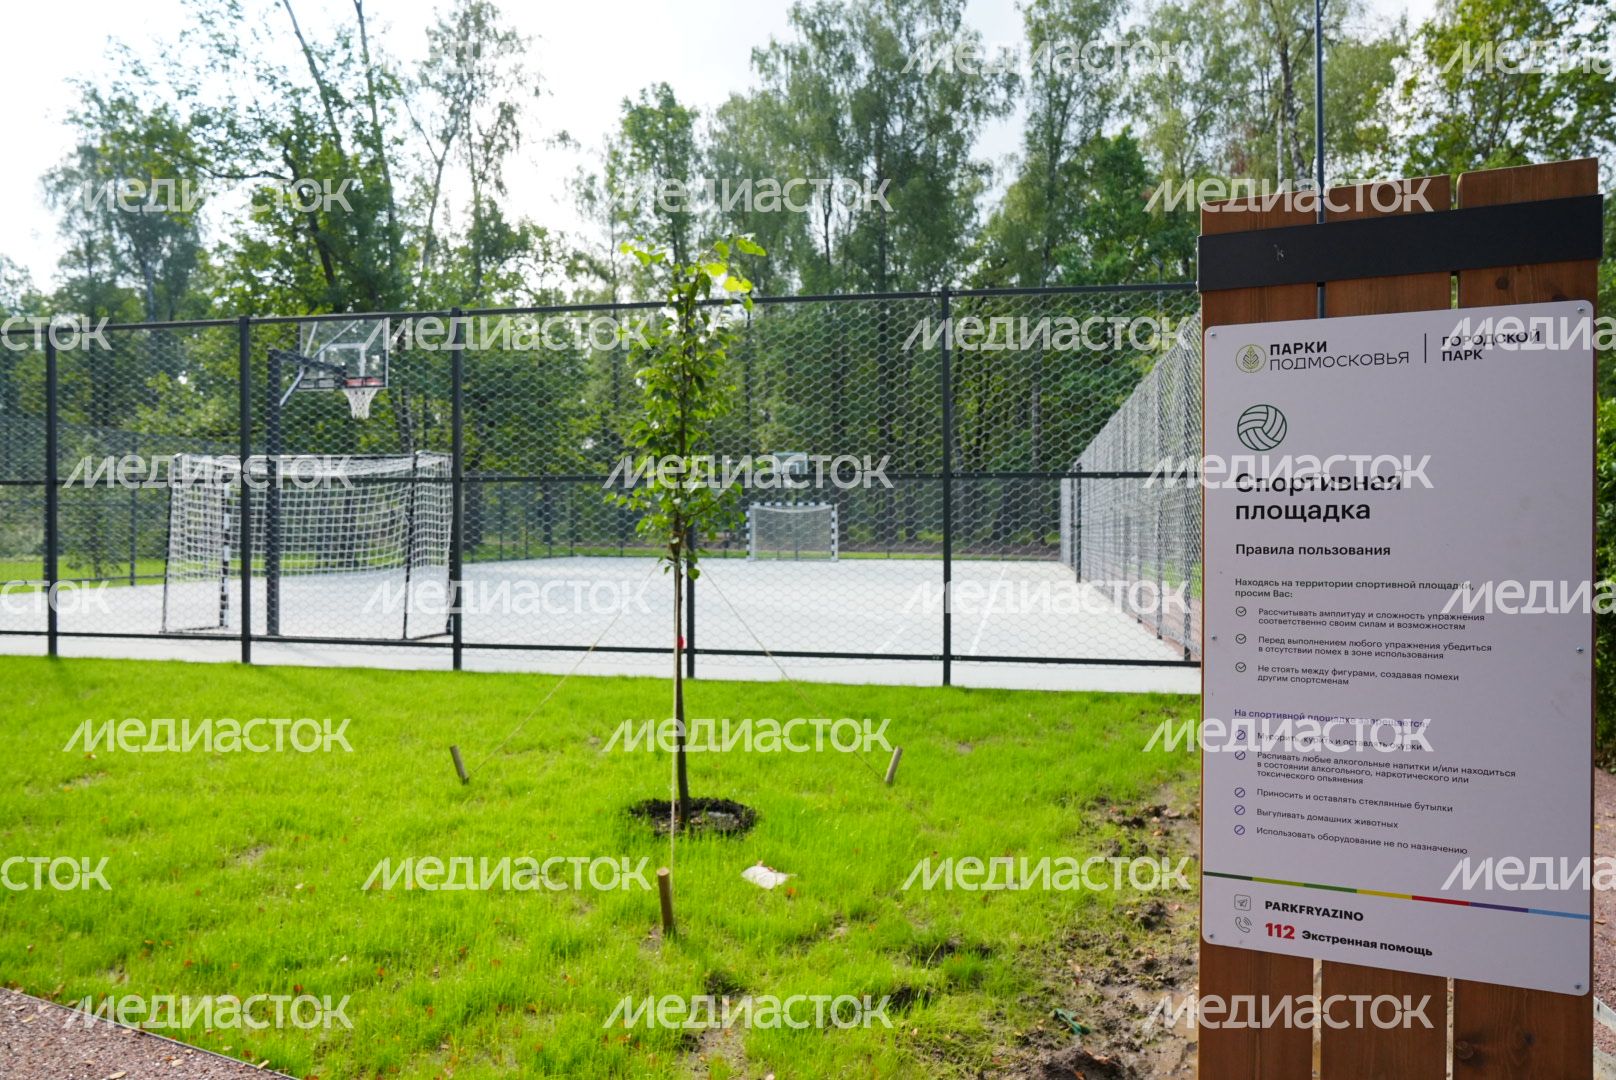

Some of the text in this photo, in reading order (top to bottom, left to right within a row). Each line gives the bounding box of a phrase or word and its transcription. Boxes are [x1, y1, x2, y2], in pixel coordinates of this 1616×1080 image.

[1442, 328, 1540, 346] ГОРОДСКОЙ
[1270, 341, 1328, 356] ПАРКИ
[1442, 349, 1482, 362] ПАРК
[1270, 351, 1408, 371] ПОДМОСКОВЬЯ
[1235, 473, 1400, 496] Спортивная
[1236, 504, 1370, 523] площадка
[1236, 543, 1390, 556] Правила пользования
[1235, 578, 1279, 587] Находясь
[1295, 580, 1353, 589] территории
[1355, 580, 1415, 589] спортивной
[1235, 589, 1292, 598] просим Вас:
[1258, 608, 1317, 617] Рассчитывать
[1319, 611, 1366, 621] амплитуду
[1376, 612, 1425, 621] сложность
[1427, 613, 1484, 622] упражнения
[1258, 618, 1326, 626] соответственно
[1359, 621, 1386, 629] силам
[1397, 622, 1466, 631] возможностям
[1258, 636, 1491, 652] Перед выполнением любого упражнения убедиться
[1265, 646, 1312, 655] отсутствии
[1314, 648, 1341, 656] помех
[1351, 649, 1372, 657] зоне
[1374, 651, 1443, 659] использования
[1257, 674, 1348, 685] другим спортсменам
[1258, 665, 1458, 681] Не стоять между фигурами, создавая помехи
[1234, 709, 1247, 717] На
[1248, 711, 1305, 721] спортивной
[1257, 751, 1515, 777] Распивать любые алкогольные напитки и/или находиться
[1257, 770, 1363, 785] токсического опьянения
[1263, 762, 1309, 771] состоянии
[1311, 765, 1372, 777] алкогольного,
[1375, 771, 1449, 782] наркотического
[1452, 776, 1469, 784] или
[1256, 788, 1303, 800] Приносить
[1312, 794, 1356, 804] оставлять
[1358, 798, 1412, 809] стеклянные
[1414, 801, 1452, 812] бутылки
[1256, 808, 1398, 829] Выгуливать домашних животных
[1256, 827, 1467, 855] Использовать оборудование не по назначению
[1265, 901, 1363, 921] PARKFRYAZINO
[1265, 922, 1432, 957] 112 Экстренная помощь
